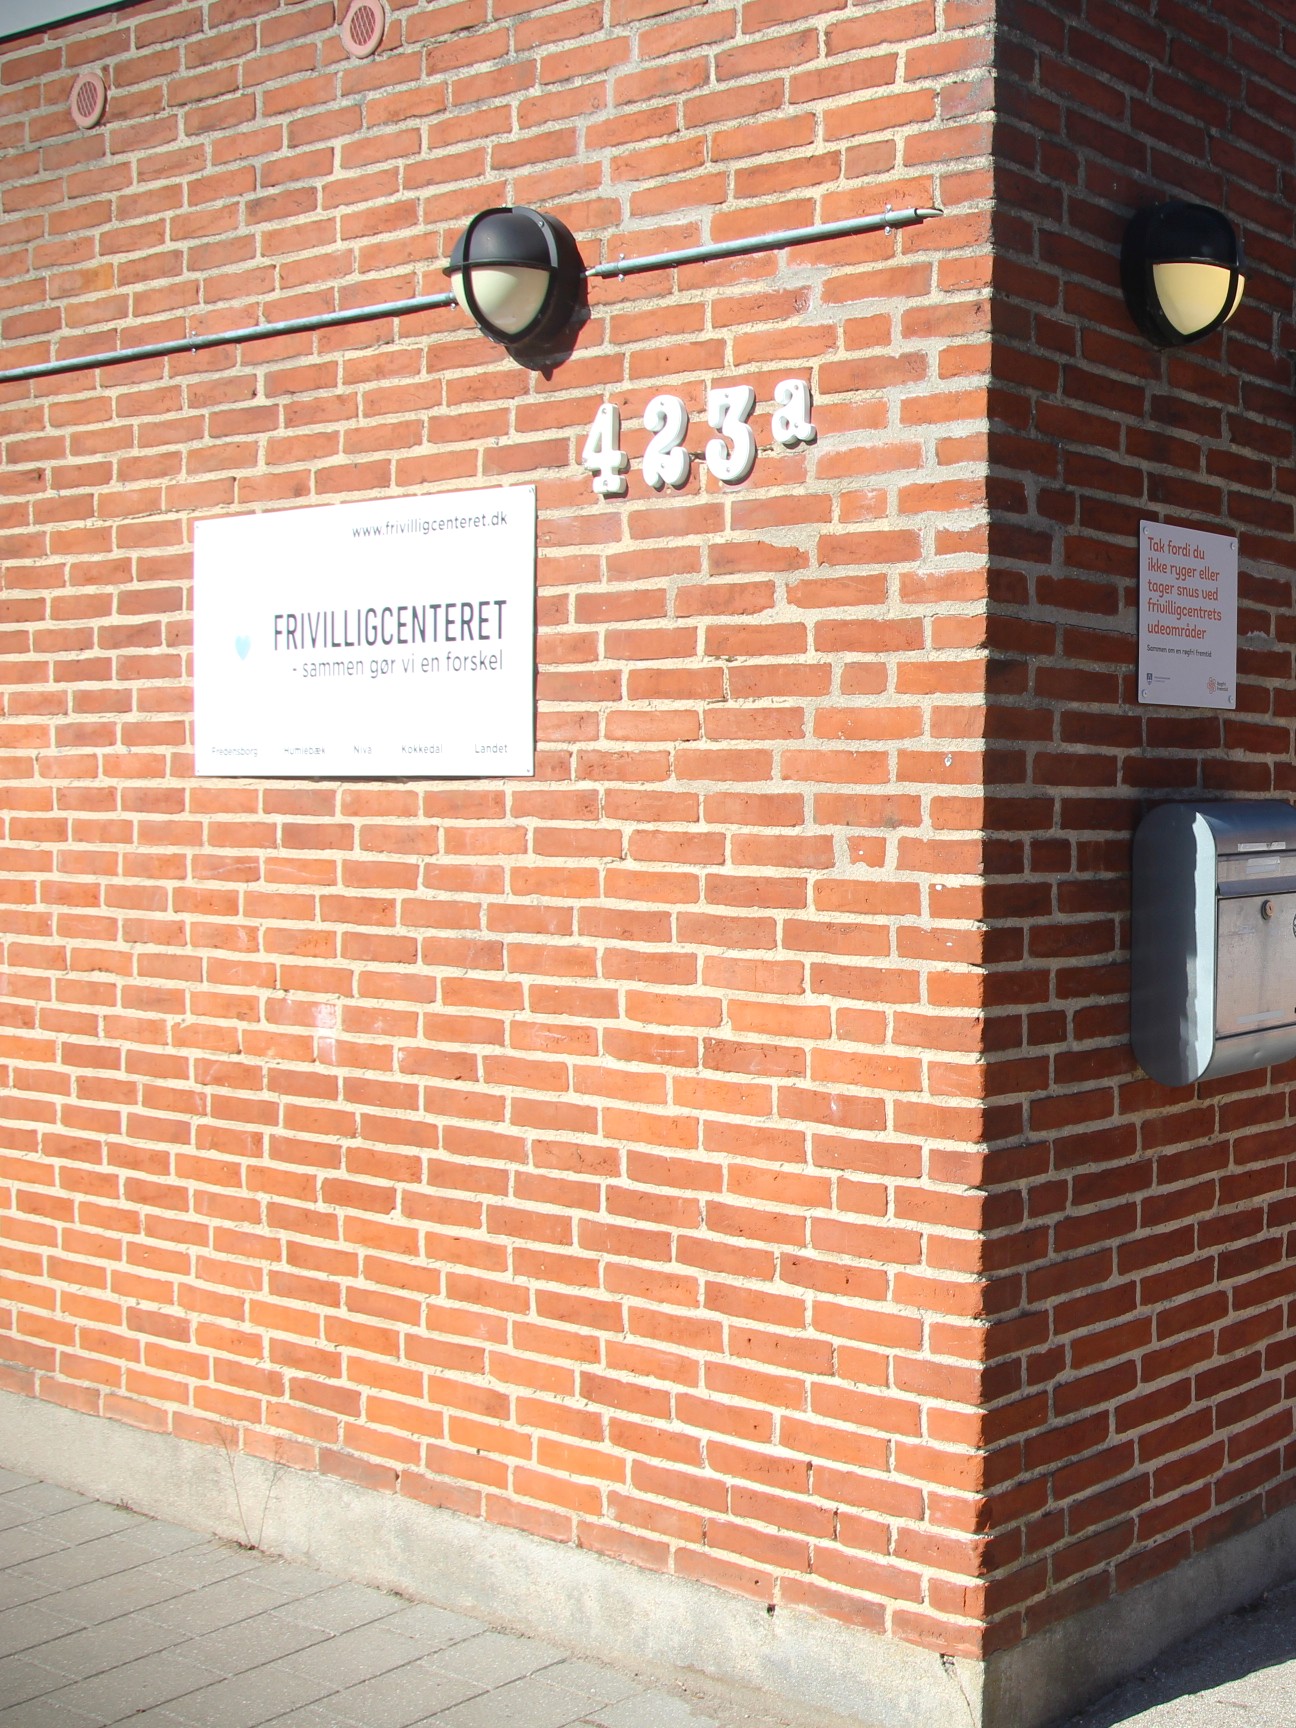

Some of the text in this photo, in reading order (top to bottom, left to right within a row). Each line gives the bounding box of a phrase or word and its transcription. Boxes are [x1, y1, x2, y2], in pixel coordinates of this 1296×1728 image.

[352, 511, 508, 538] www.frivilligcenteret.dk
[1147, 537, 1205, 560] Tak fordi du
[1147, 557, 1220, 582] ikke ryger eller
[1147, 579, 1219, 601] tager snus ved
[1147, 598, 1222, 621] frivilligcentrets
[273, 600, 507, 651] FRIVILLIGCENTERET
[1147, 619, 1207, 640] udeområder
[1146, 644, 1167, 653] Sammen
[1195, 649, 1212, 658] fremtid
[302, 660, 364, 678] sammen
[370, 657, 396, 679] gør
[402, 653, 415, 673] vi
[421, 654, 440, 673] en
[446, 650, 503, 672] forskel
[401, 744, 443, 754] Kokkedal
[474, 743, 508, 754] Landet
